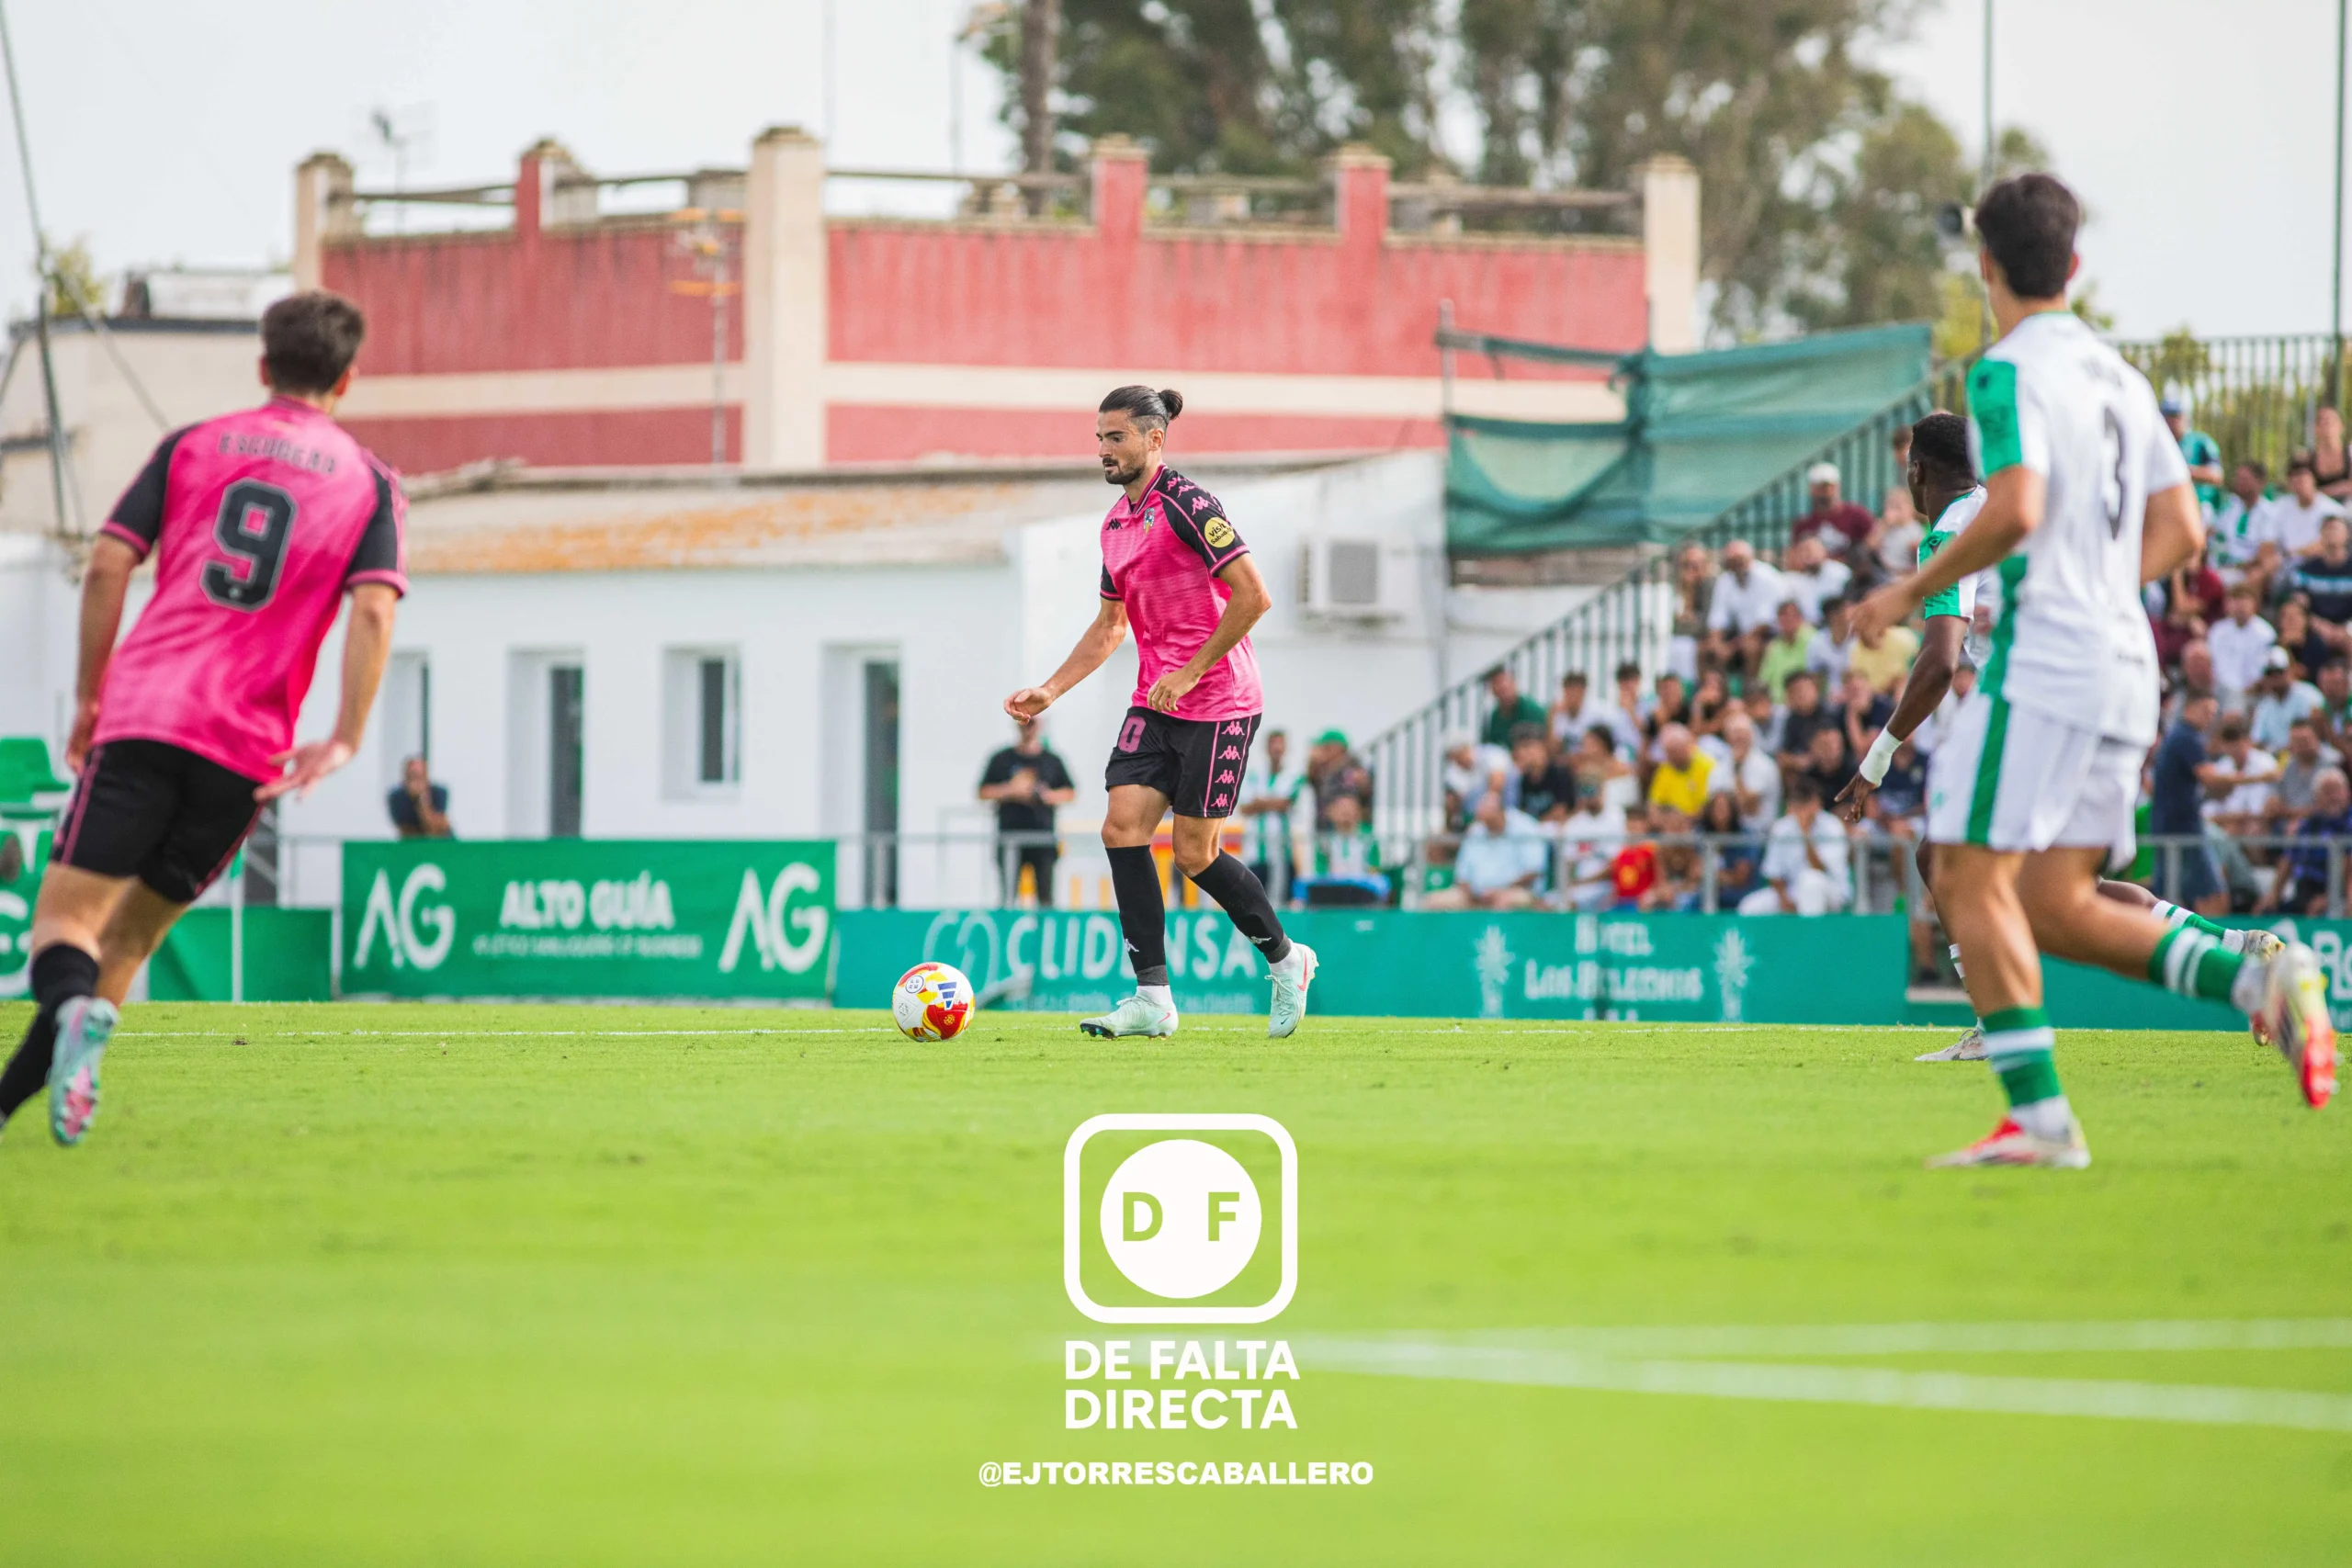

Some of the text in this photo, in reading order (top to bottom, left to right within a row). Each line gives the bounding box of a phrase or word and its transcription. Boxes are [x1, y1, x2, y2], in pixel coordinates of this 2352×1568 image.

[200, 477, 299, 613] 9
[499, 869, 675, 931] ALTO GUÍA
[1006, 915, 1257, 980] CLIDNSA
